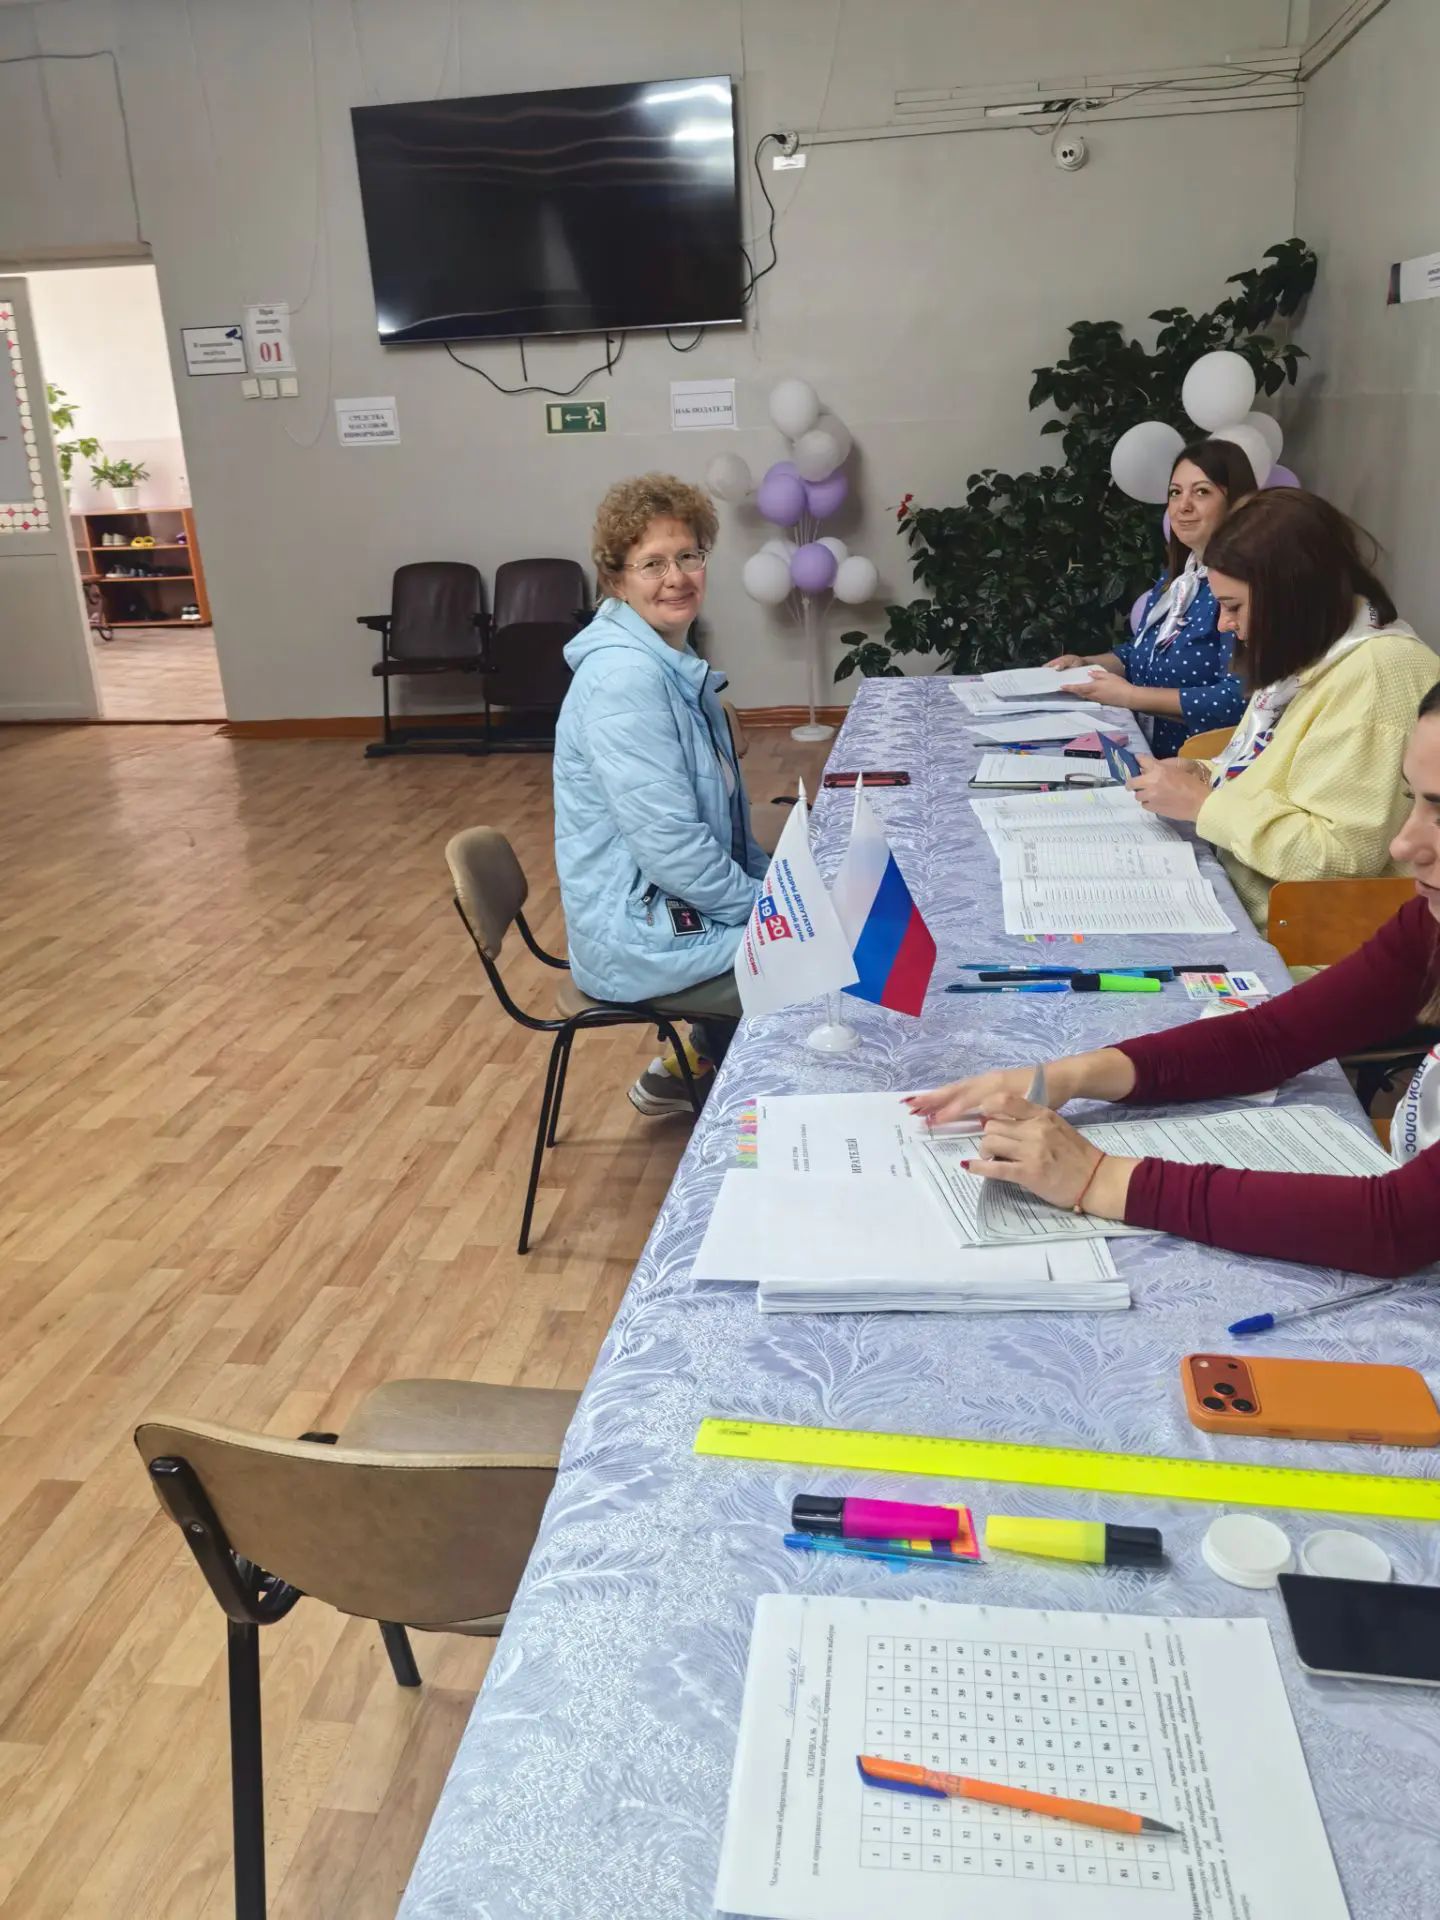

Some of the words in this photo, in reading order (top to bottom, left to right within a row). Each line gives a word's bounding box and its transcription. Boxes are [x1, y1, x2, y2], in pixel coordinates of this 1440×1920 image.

[259, 342, 284, 363] 01
[760, 899, 773, 917] 19
[769, 917, 786, 938] 20
[774, 860, 799, 922] ГОСУДАРСТВЕННОЙ
[793, 922, 805, 943] ДУМЫ
[781, 858, 798, 894] ВЫБОРЫ
[793, 893, 815, 938] ДЕПУТАТОВ
[1405, 1104, 1418, 1153] ГОЛОС
[806, 1737, 817, 1778] ТАБЛИЧКА
